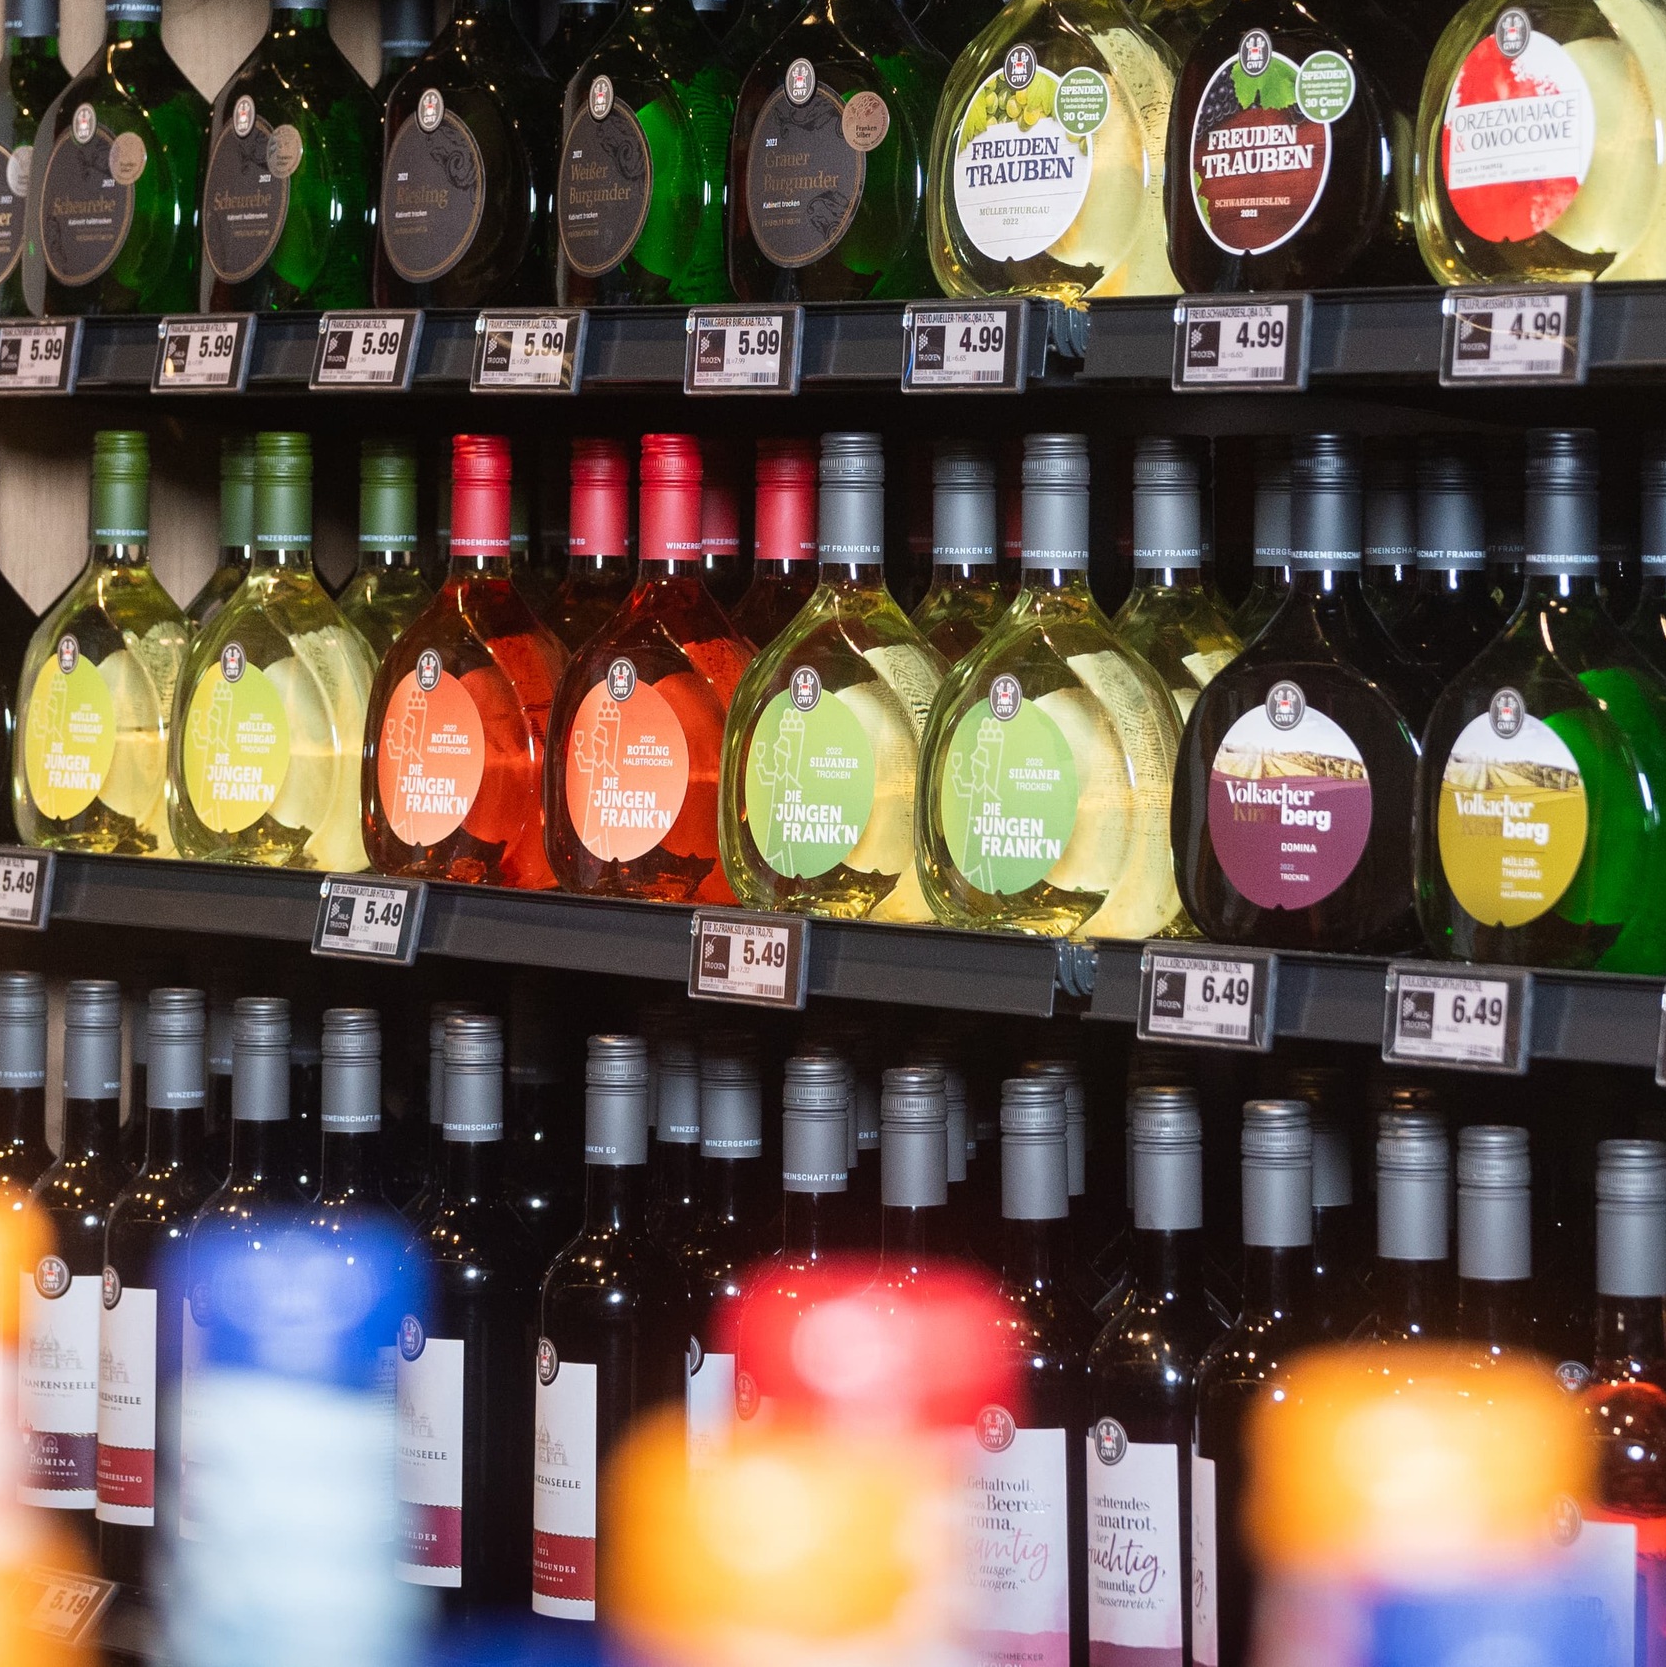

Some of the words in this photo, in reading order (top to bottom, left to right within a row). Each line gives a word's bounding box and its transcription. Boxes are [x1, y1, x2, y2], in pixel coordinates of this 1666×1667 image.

[1247, 61, 1263, 69] GWF
[1011, 75, 1027, 83] GWF
[1302, 70, 1347, 80] SPENDEN
[793, 88, 807, 97] GWF
[1061, 85, 1103, 95] SPENDEN
[1305, 99, 1317, 107] 30
[1319, 97, 1344, 107] Cent
[1063, 113, 1075, 121] 30
[1077, 111, 1100, 121] Cent
[1207, 124, 1297, 151] FREUDEN
[1471, 121, 1572, 150] OWOCOWE
[971, 137, 1060, 160] FREUDEN
[764, 151, 811, 168] Grauer
[1202, 144, 1314, 179] TRAUBEN
[571, 163, 608, 182] Weißer
[966, 157, 1075, 188] TRAUBEN
[763, 171, 839, 195] Burgunder
[214, 191, 272, 210] Scheurebe
[395, 185, 449, 209] Riesling
[569, 182, 631, 208] Burgunder
[1215, 197, 1291, 207] SCHWARZRIESLING
[53, 196, 116, 215] Scheurebe
[1240, 209, 1258, 217] 2021
[1509, 312, 1561, 340] 4.99
[959, 327, 1004, 354] 4.99
[1236, 320, 1284, 348] 4.99
[197, 334, 233, 358] 5.99
[361, 332, 399, 356] 5.99
[524, 333, 564, 357] 5.99
[737, 329, 780, 355] 5.99
[30, 338, 63, 361] 5.99
[918, 354, 941, 362] TROCKEN
[613, 686, 629, 695] GWF
[797, 696, 813, 704] GWF
[996, 705, 1013, 713] GWF
[1275, 714, 1294, 722] GWF
[68, 723, 103, 735] THURGAU
[238, 721, 275, 732] MÜLLER-
[235, 733, 277, 745] THURGAU
[431, 734, 469, 745] ROTLING
[640, 735, 656, 744] 2022
[51, 741, 64, 753] DIE
[427, 745, 471, 756] HALBTROCKEN
[626, 745, 670, 757] ROTLING
[825, 746, 843, 755] 2022
[44, 753, 90, 772] JUNGEN
[215, 753, 230, 765] DIE
[623, 757, 673, 767] HALBTROCKEN
[809, 757, 859, 769] SILVANER
[1025, 758, 1043, 766] 2022
[207, 765, 263, 783] JUNGEN
[408, 763, 423, 777] DIE
[816, 770, 851, 779] TROCKEN
[1008, 768, 1061, 781] SILVANER
[401, 777, 455, 796] JUNGEN
[602, 776, 619, 790] DIE
[1015, 782, 1052, 791] TROCKEN
[594, 790, 656, 809] JUNGEN
[785, 789, 802, 802] DIE
[1225, 780, 1315, 806] Volkacher
[983, 802, 1001, 816] DIE
[1454, 791, 1534, 819] Volkacher
[775, 803, 842, 823] JUNGEN
[973, 817, 1044, 837] JUNGEN
[1281, 842, 1317, 853] DOMINA
[1280, 873, 1310, 882] TROCKEN
[1501, 867, 1542, 880] THURGAU
[1, 868, 35, 894] 5.49
[363, 901, 403, 927] 5.49
[743, 939, 786, 968] 5.49
[704, 961, 726, 970] TROCKEN
[1201, 975, 1250, 1006] 6.49
[1451, 995, 1503, 1026] 6.49
[29, 1453, 76, 1469] DOMINA
[1101, 1450, 1117, 1458] GWF
[50, 1588, 91, 1617] 5.19
